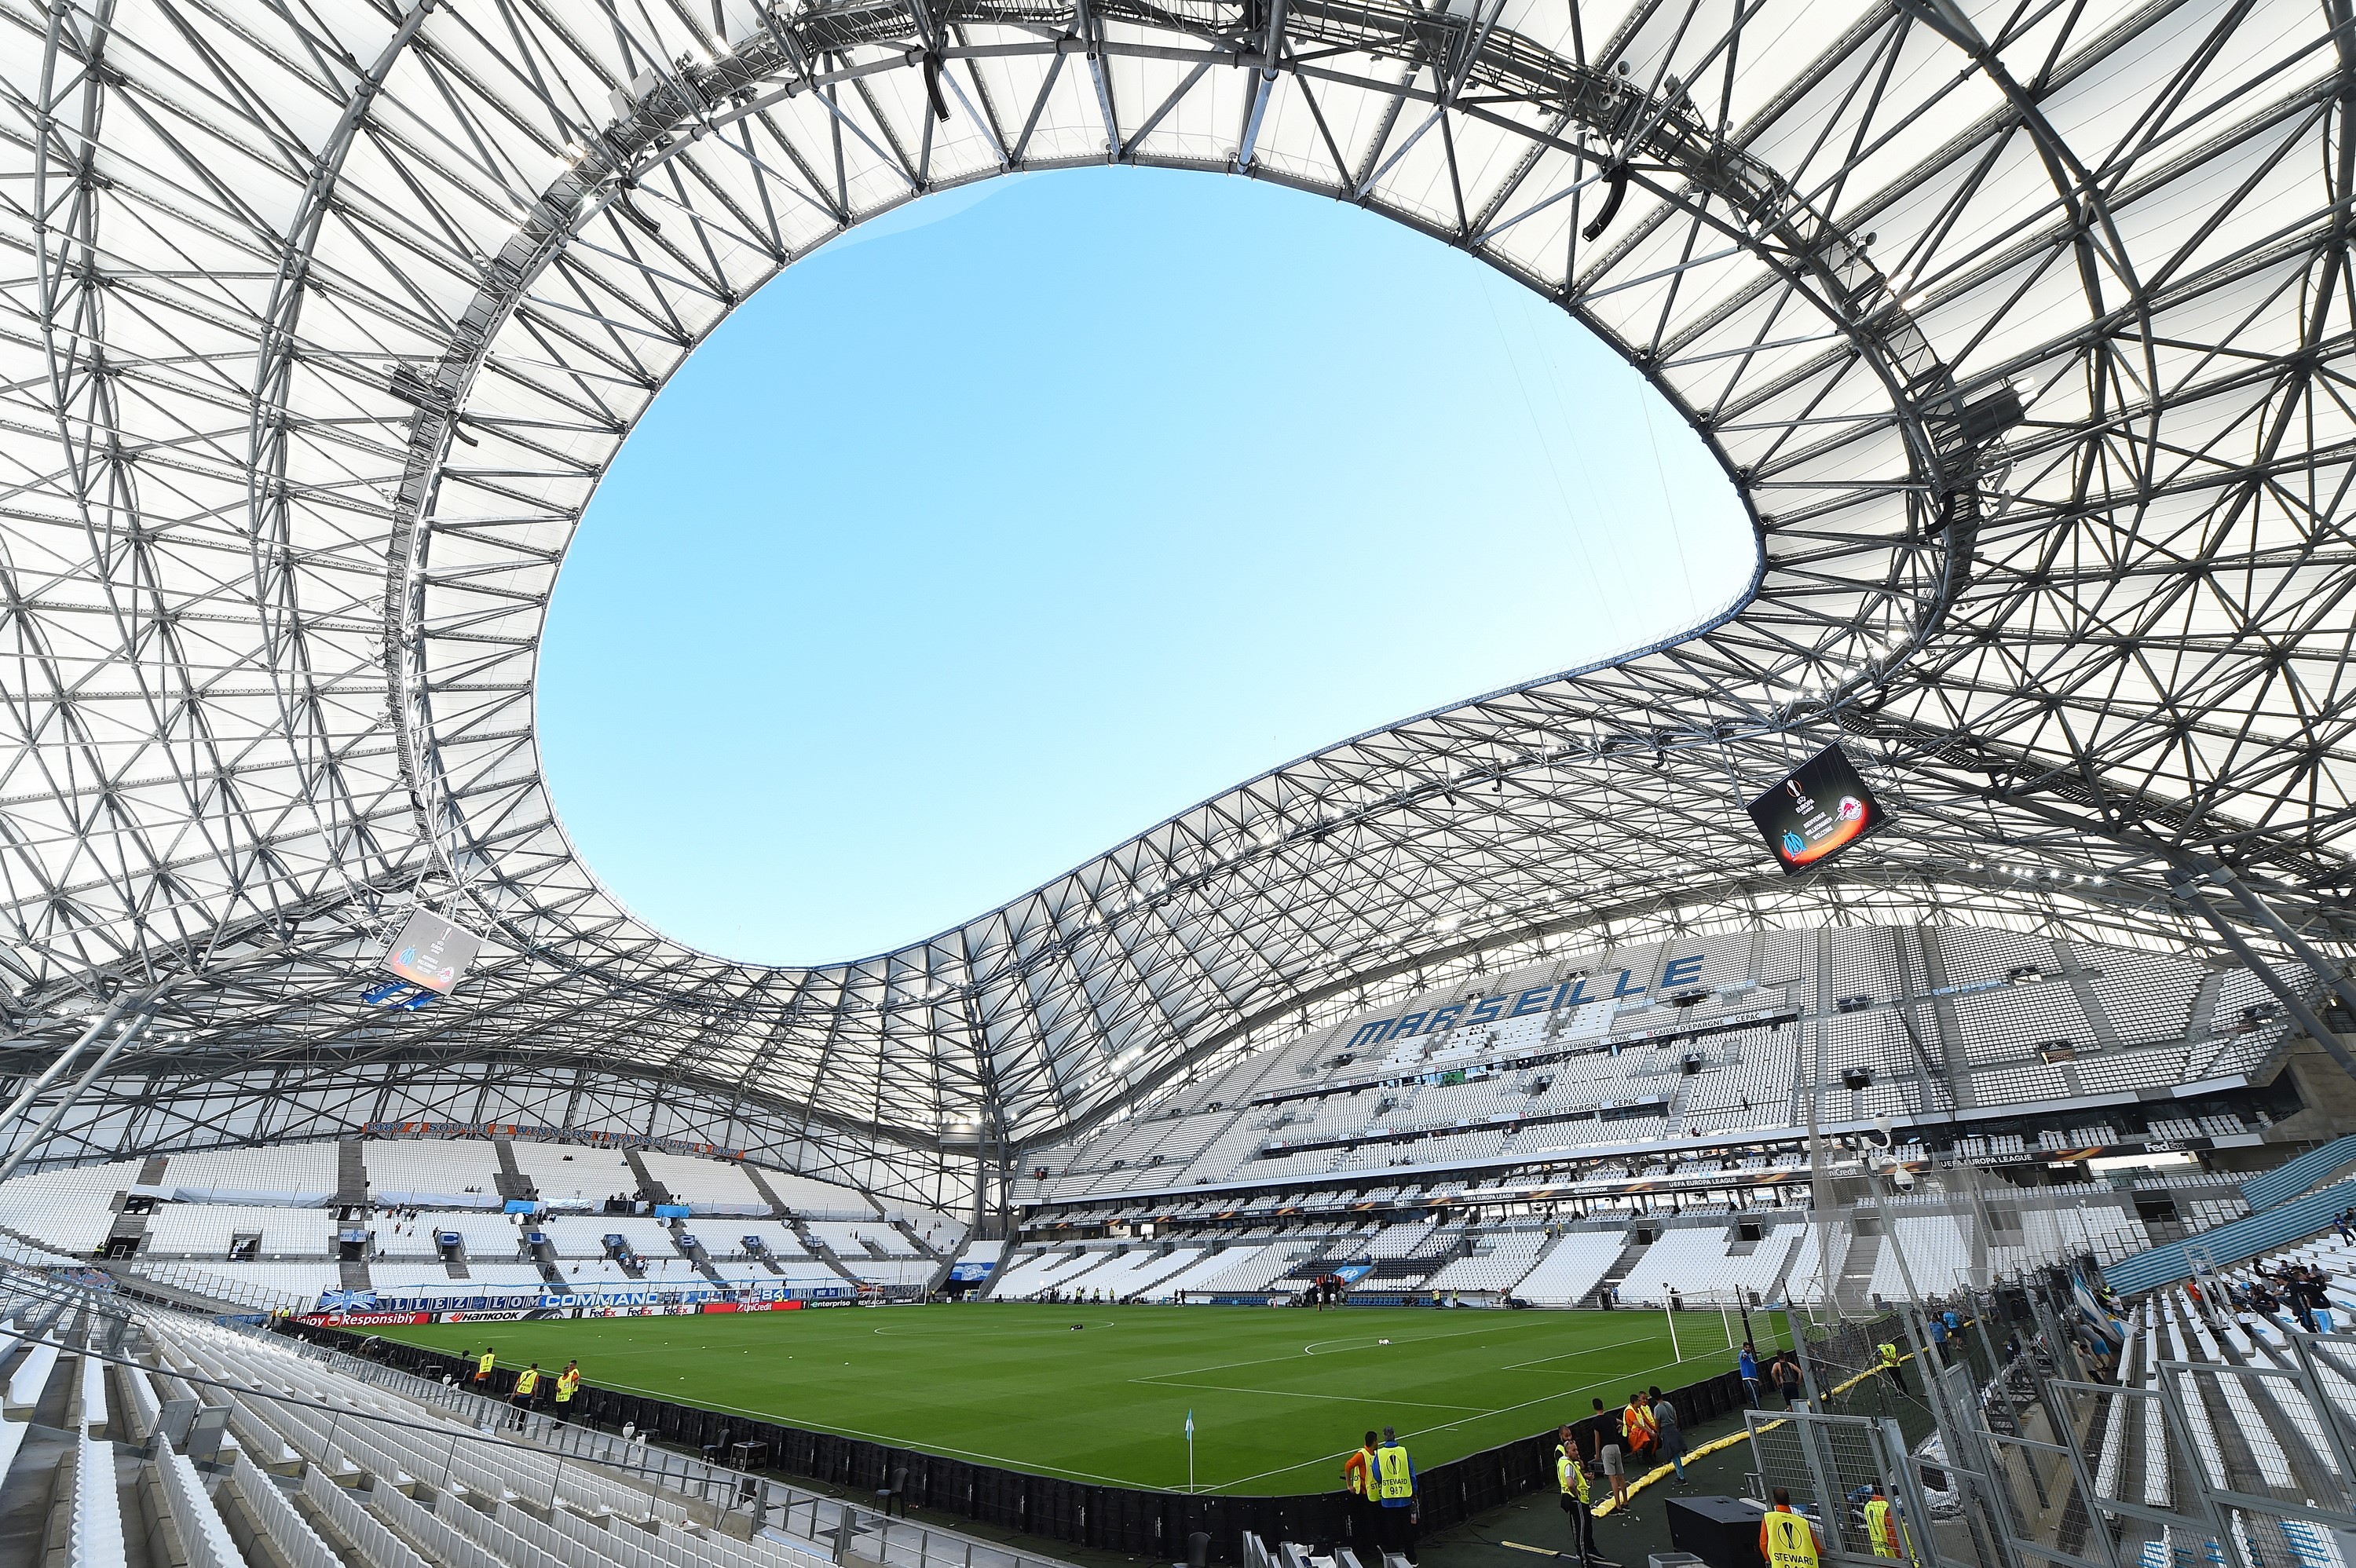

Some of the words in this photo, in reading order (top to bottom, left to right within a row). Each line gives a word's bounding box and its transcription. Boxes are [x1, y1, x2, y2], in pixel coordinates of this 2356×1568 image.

[1813, 825, 1834, 841] WELCOME
[1345, 956, 1704, 1049] MARSEILLE
[1736, 1013, 1761, 1022] CEPAC
[1653, 1027, 1677, 1036] CAISSE
[1610, 1035, 1632, 1044] CEPAC
[1539, 1046, 1560, 1054] CAISSE
[1612, 1098, 1640, 1107] CEPAC
[1527, 1109, 1553, 1118] CAISSE
[1469, 1116, 1491, 1125] CEPAC
[1394, 1124, 1417, 1134] CAISSE
[366, 1123, 405, 1133] 1987
[429, 1123, 489, 1132] SOUTH
[515, 1125, 592, 1139] WINNERS
[609, 1133, 696, 1150] MARSEILLE
[711, 1146, 741, 1157] 1987
[2144, 1141, 2187, 1153] FedEx
[1999, 1153, 2033, 1164] LEAGUE
[374, 1298, 465, 1310] ALLEZ
[491, 1296, 543, 1309] L'OM
[744, 1303, 773, 1311] UniCredit
[590, 1307, 617, 1318] FedEx
[628, 1307, 653, 1317] FedEx
[342, 1314, 417, 1325] Responsibly
[1382, 1478, 1408, 1486] STEWARD
[1773, 1552, 1814, 1566] STEWARD
